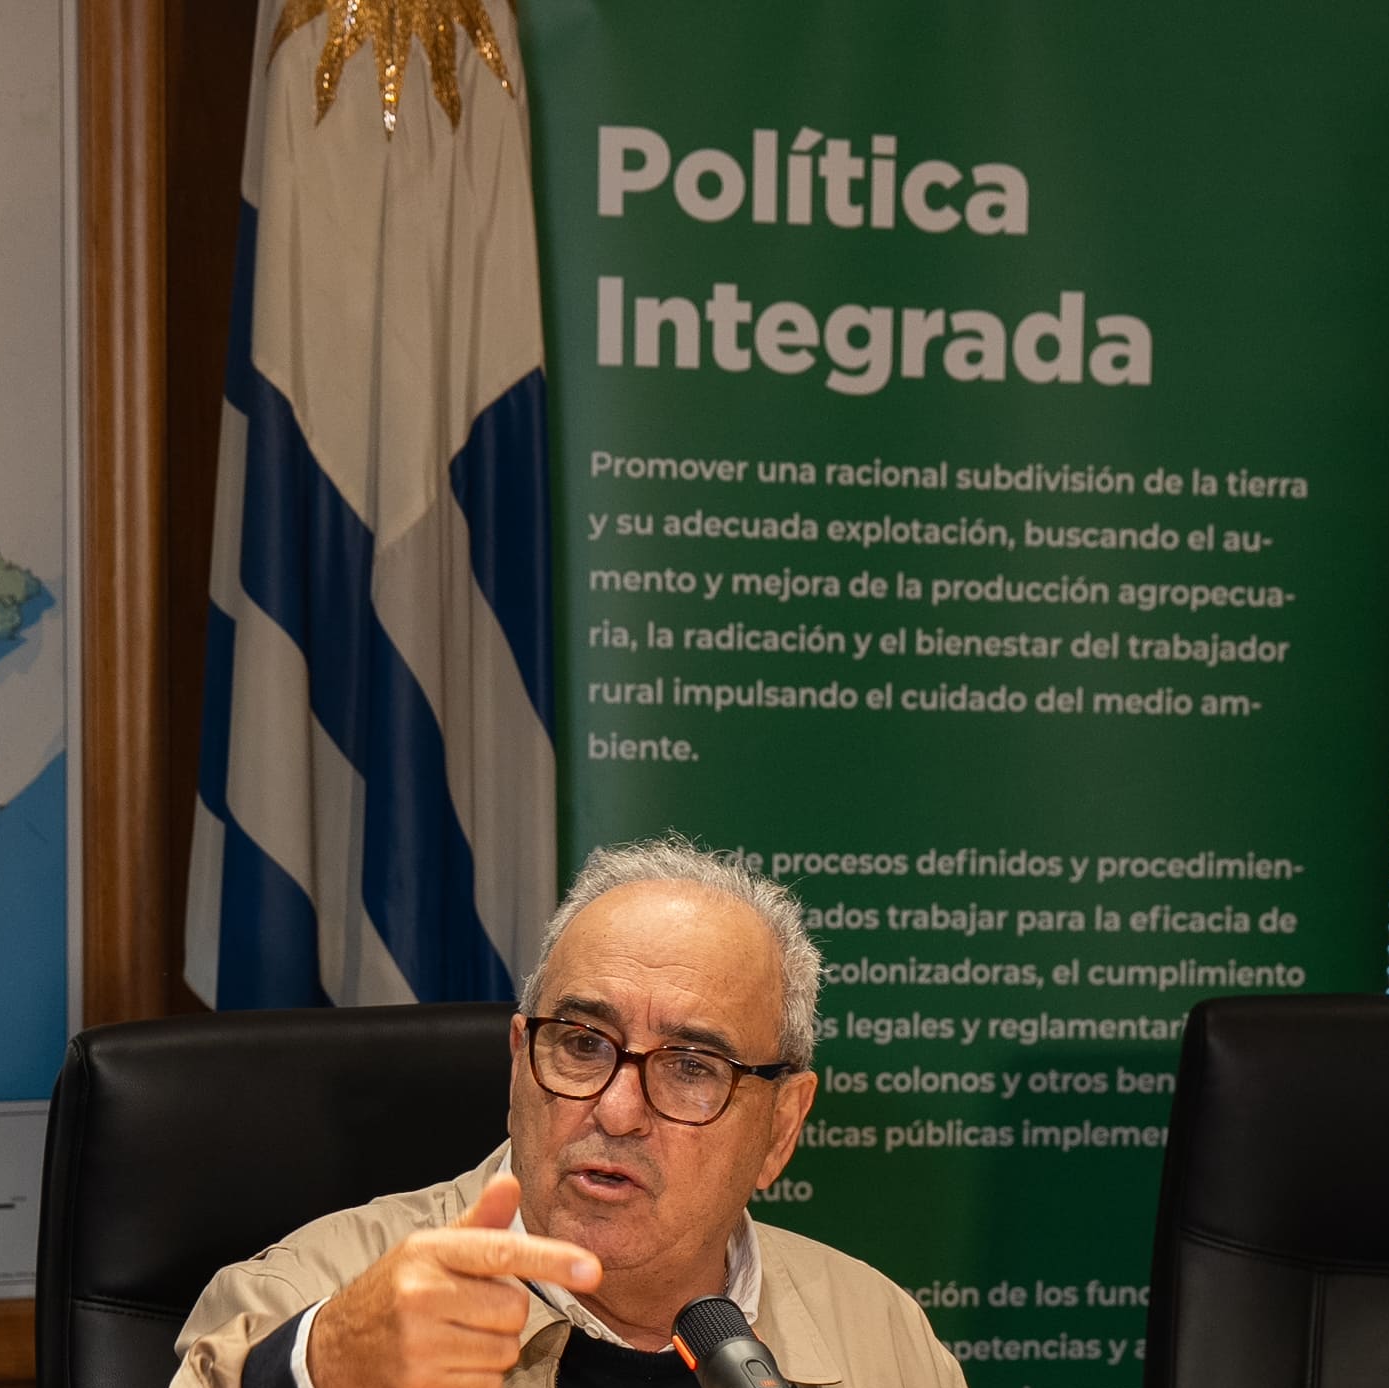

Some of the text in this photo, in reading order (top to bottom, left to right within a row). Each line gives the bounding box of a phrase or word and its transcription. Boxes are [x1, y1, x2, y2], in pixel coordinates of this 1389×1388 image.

[597, 125, 1029, 235] Política
[596, 275, 1152, 395] Integrada
[590, 449, 1308, 499] Promover una racional subdivisión de la tierra
[588, 509, 1273, 553] y su adecuada explotación, buscando el au-
[589, 567, 1295, 612] mento y mejora de la producción agropecua-
[647, 621, 674, 649] la
[683, 622, 846, 653] radicación
[853, 633, 873, 660] y
[879, 627, 907, 655] el
[915, 627, 1063, 658] bienestar
[1070, 632, 1120, 659] del
[1127, 633, 1289, 668] trabajador
[588, 676, 1261, 716] rural impulsando el cuidado del medio am-
[587, 730, 699, 761] biente.
[770, 852, 909, 882] procesos
[915, 848, 1064, 877] definidos
[1069, 857, 1090, 883] y
[1096, 851, 1303, 884] procedimien-
[806, 902, 1298, 937] ados trabajar para la eficacia de
[823, 956, 1306, 992] colonizadoras, el cumplimiento
[846, 1011, 955, 1045] legales
[961, 1018, 981, 1045] y
[825, 1066, 869, 1093] los
[875, 1066, 996, 1093] colonos
[1001, 1072, 1022, 1099] y
[1027, 1069, 1109, 1094] otros
[885, 1119, 1014, 1153] públicas
[1022, 1119, 1169, 1152] impleme
[918, 1280, 981, 1309] ción
[987, 1281, 1028, 1307] de
[1035, 1280, 1079, 1307] los
[956, 1332, 1103, 1362] petencias
[1107, 1339, 1128, 1366] y
